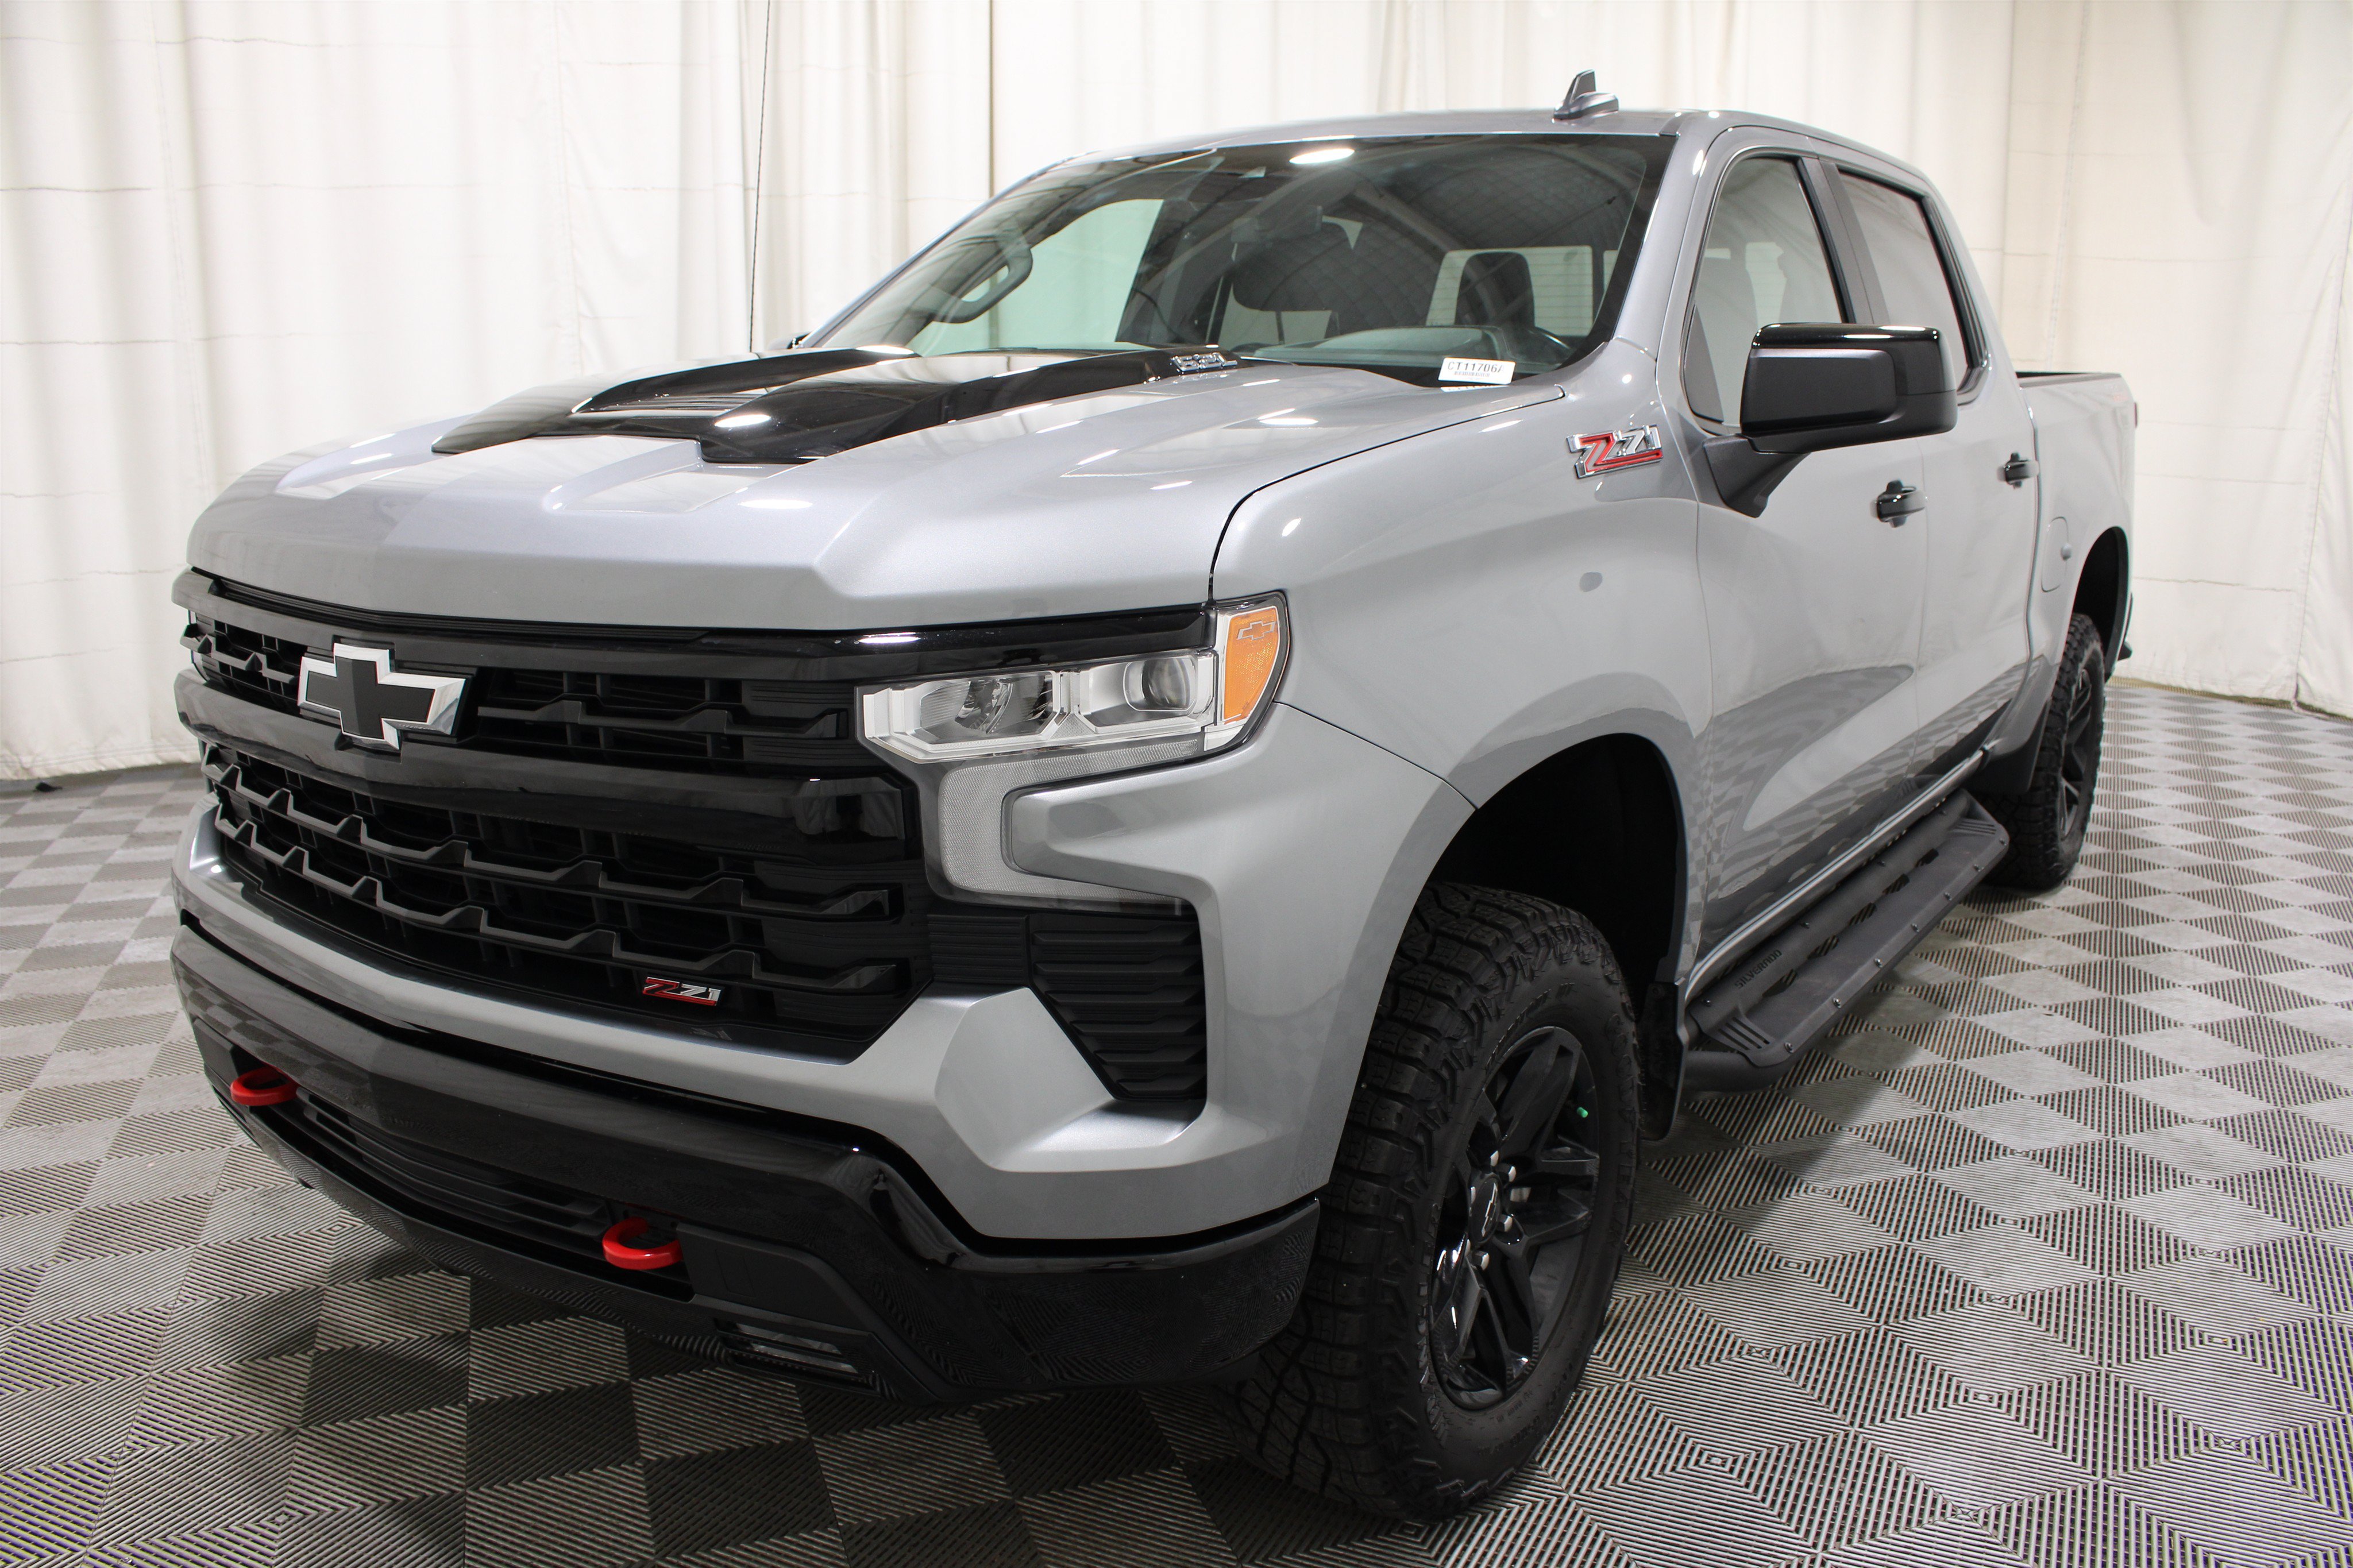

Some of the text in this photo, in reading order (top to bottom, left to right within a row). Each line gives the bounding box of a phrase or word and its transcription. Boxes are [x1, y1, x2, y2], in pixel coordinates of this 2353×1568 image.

[1567, 424, 1664, 478] Z71
[1734, 949, 1783, 989] SILVERADO
[642, 976, 725, 1006] Z71
